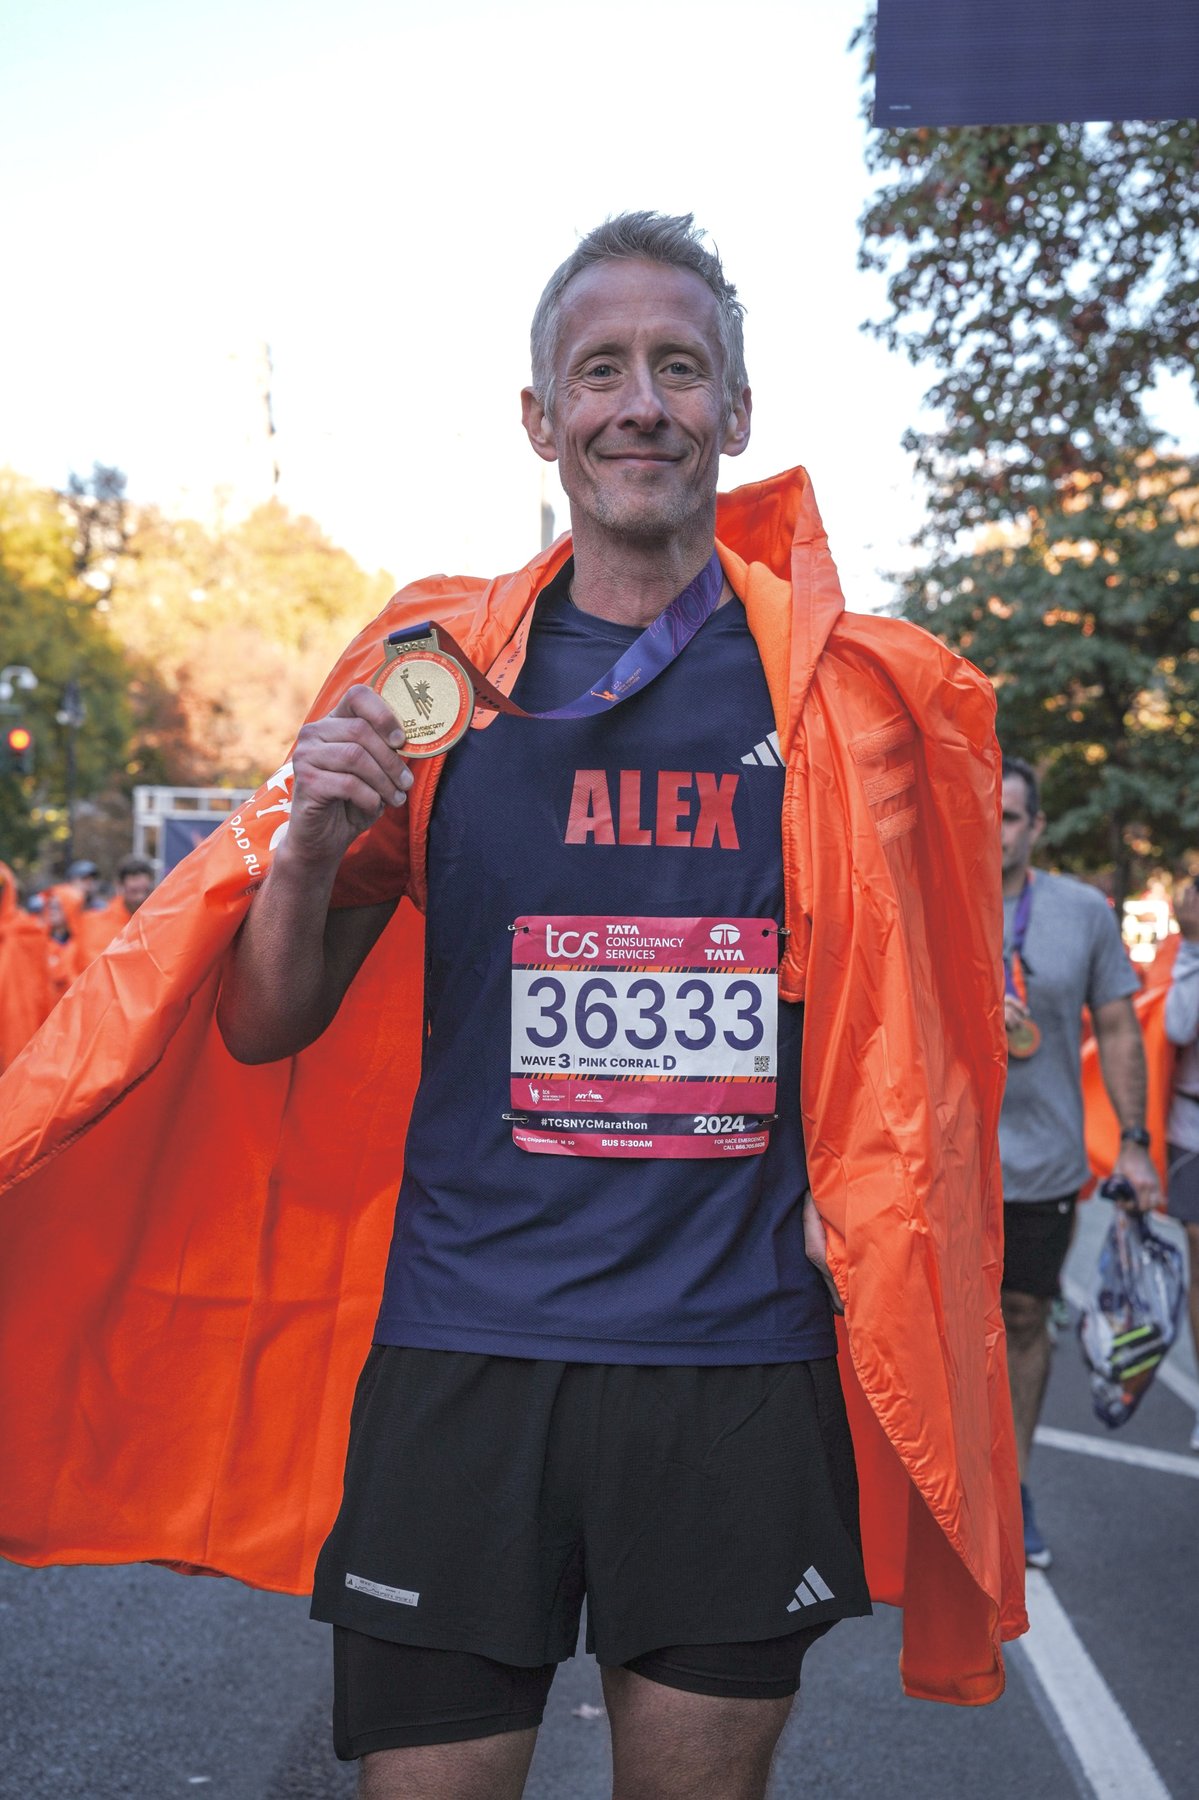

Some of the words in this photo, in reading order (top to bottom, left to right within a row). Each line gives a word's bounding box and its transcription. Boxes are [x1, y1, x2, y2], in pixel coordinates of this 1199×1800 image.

[564, 769, 740, 850] ALEX
[606, 925, 640, 935] TATA
[546, 923, 599, 959] tcs
[605, 937, 684, 948] CONSULTANCY
[605, 949, 656, 960] SERVICES
[704, 949, 745, 961] TATA
[525, 976, 764, 1051] 36333
[521, 1055, 556, 1066] WAVE
[558, 1053, 571, 1069] 3
[579, 1057, 607, 1068] PINK
[610, 1058, 660, 1069] CORRAL
[662, 1055, 677, 1071] D
[540, 1118, 648, 1131] #TCSNYCMarathon
[693, 1115, 745, 1134] 2024
[601, 1139, 619, 1147] BUS
[620, 1139, 653, 1148] 5:30AM
[714, 1138, 724, 1146] FOR
[725, 1137, 738, 1145] RACE
